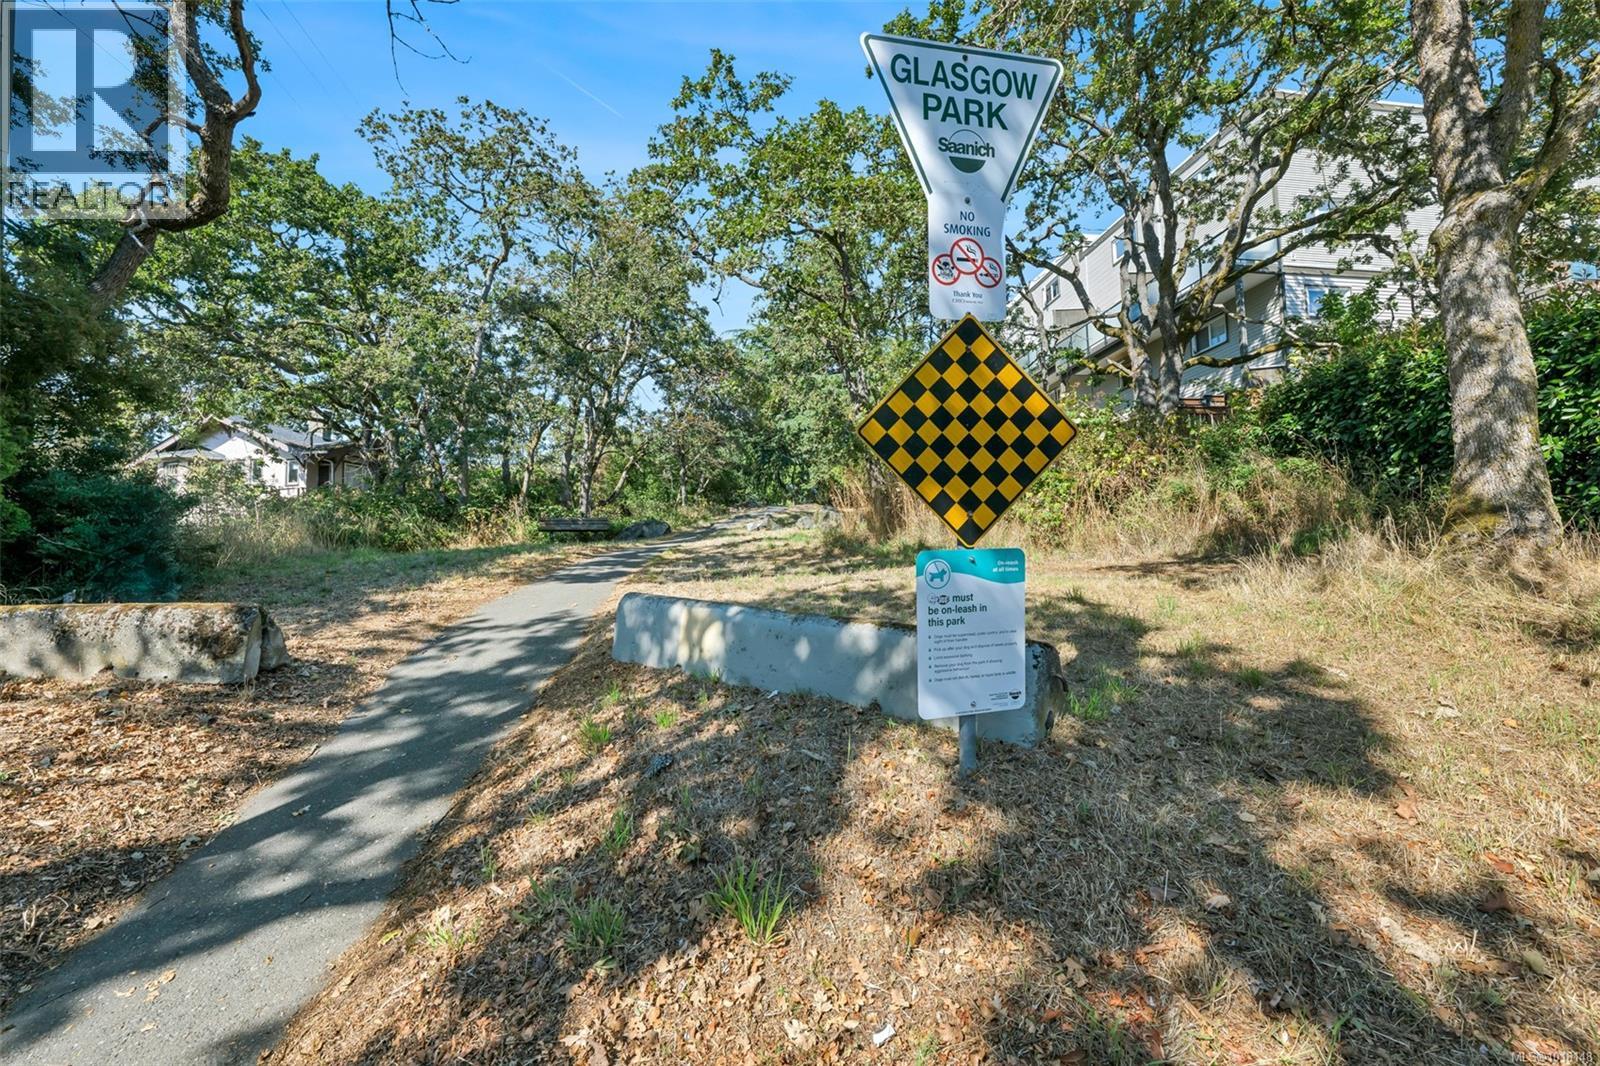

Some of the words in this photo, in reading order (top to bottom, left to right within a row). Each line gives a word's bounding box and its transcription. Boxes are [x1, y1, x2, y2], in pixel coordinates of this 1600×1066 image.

[890, 53, 1038, 100] GLASGOW
[923, 93, 1009, 131] PARK
[938, 137, 996, 158] Saanich
[960, 211, 975, 221] NO
[943, 223, 991, 237] SMOKING
[953, 290, 970, 298] Thank
[972, 291, 983, 299] You
[952, 593, 974, 601] must
[928, 606, 939, 615] be
[941, 604, 977, 614] on-leash
[979, 603, 987, 612] in
[928, 618, 944, 627] this
[946, 616, 965, 628] park
